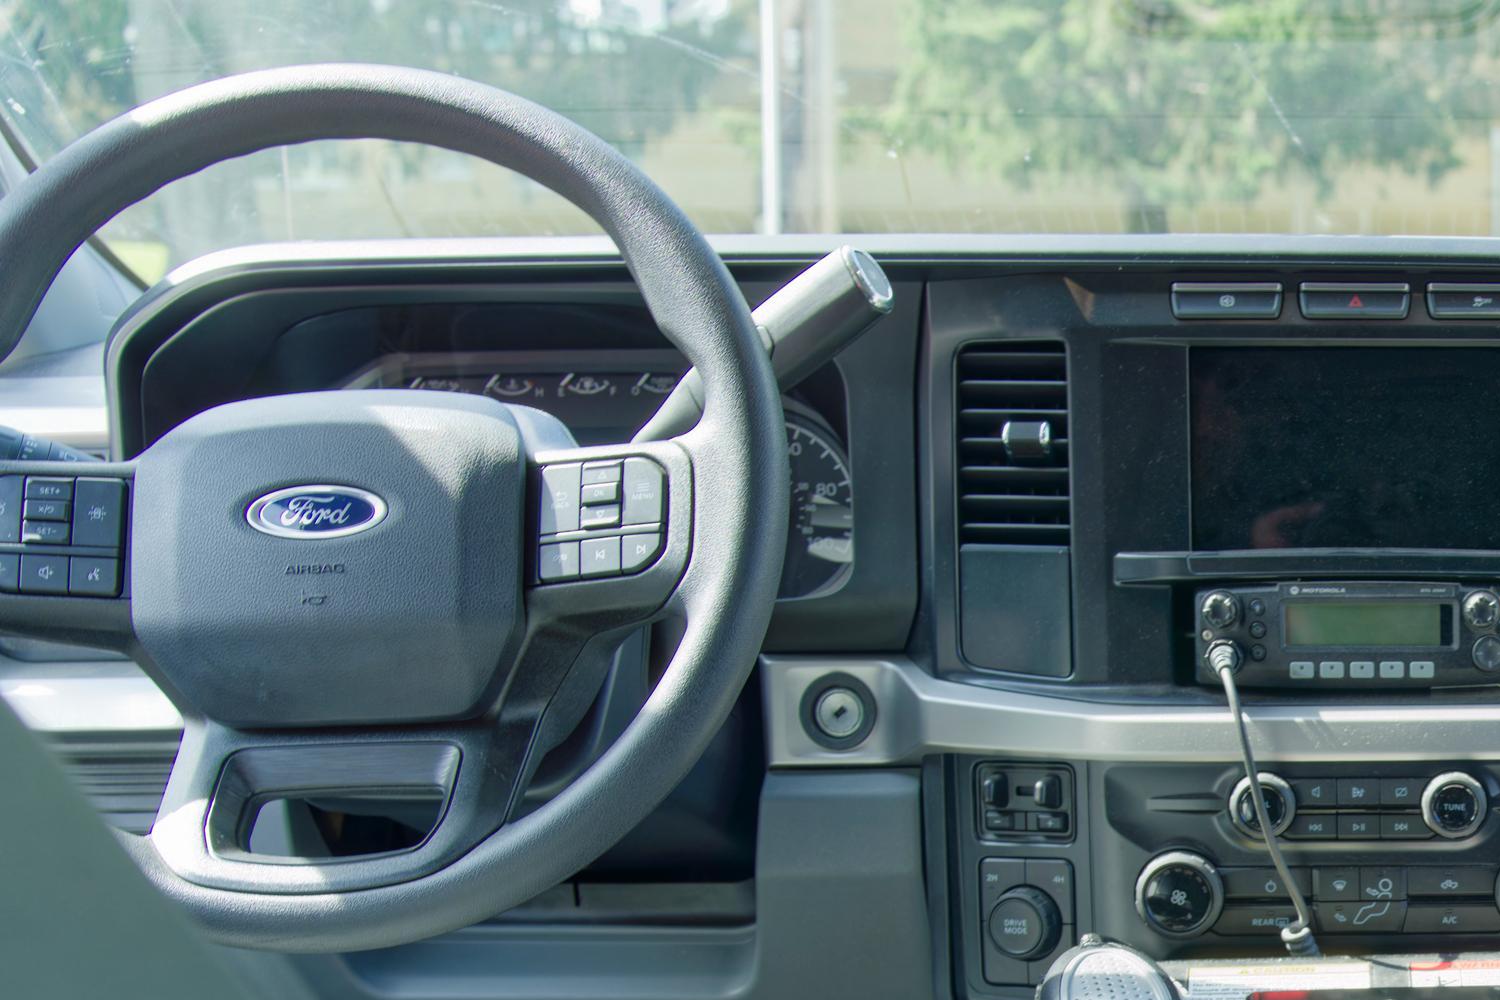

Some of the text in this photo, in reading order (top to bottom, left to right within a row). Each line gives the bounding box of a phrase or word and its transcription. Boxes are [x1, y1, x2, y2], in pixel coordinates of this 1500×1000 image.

[815, 482, 838, 497] 80
[279, 495, 352, 527] Ford
[284, 563, 346, 576] AIRBAG
[1301, 586, 1347, 594] MOTOROLA
[1443, 803, 1467, 811] TUNE
[985, 873, 999, 882] 2H
[1052, 875, 1066, 884] 4H
[1003, 919, 1028, 927] DRIVE
[1251, 918, 1275, 926] REAR
[1442, 916, 1458, 925] A/C
[1003, 927, 1029, 935] MODE
